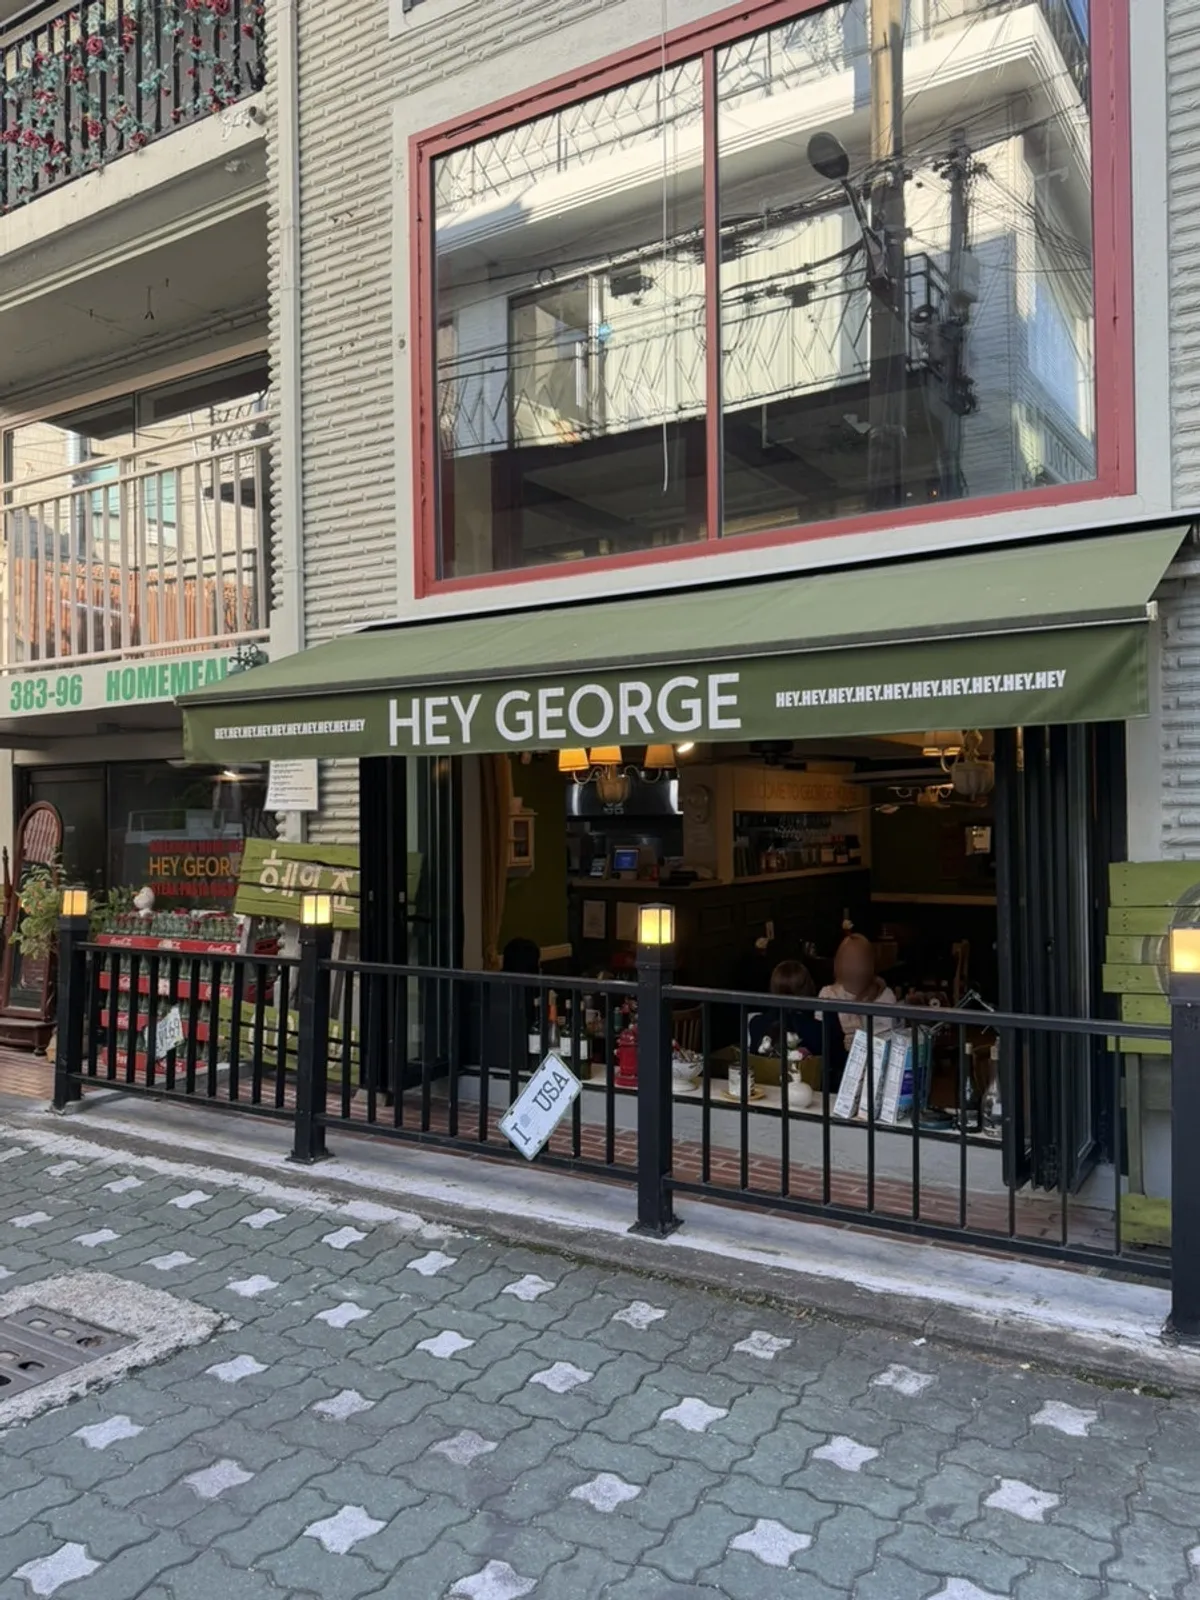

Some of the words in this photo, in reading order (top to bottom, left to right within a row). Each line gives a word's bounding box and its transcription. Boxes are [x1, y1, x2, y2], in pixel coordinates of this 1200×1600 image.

[10, 674, 83, 712] 383-96
[388, 693, 482, 746] HEY
[494, 673, 742, 742] GEORGE
[149, 856, 181, 877] HEY
[511, 1122, 531, 1145] I
[531, 1071, 570, 1112] USA
